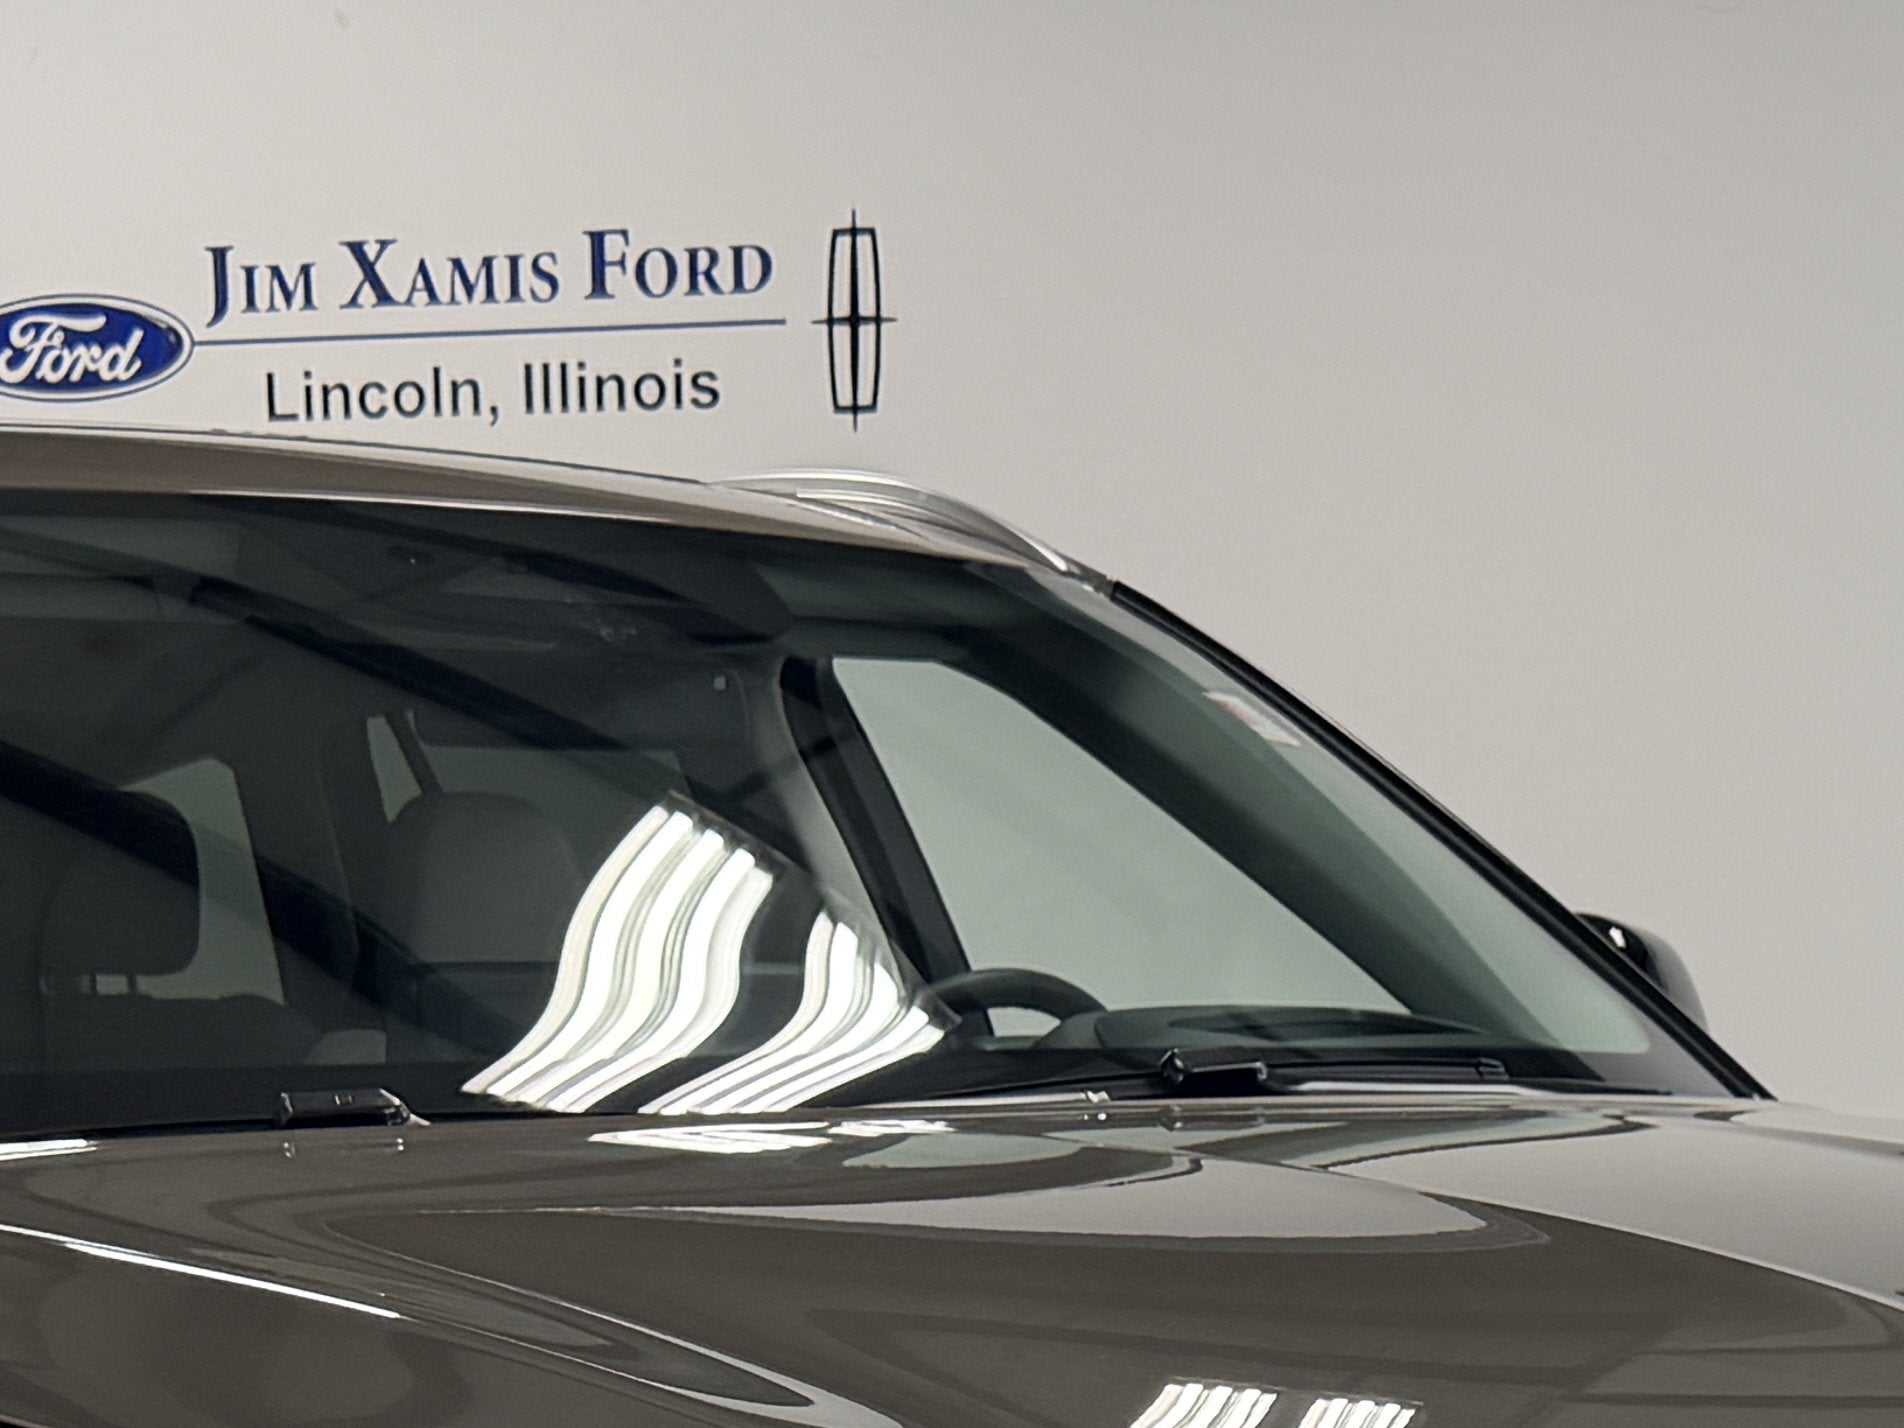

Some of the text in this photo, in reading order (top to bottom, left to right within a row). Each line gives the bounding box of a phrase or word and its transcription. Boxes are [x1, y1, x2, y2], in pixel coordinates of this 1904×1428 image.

[204, 228, 774, 329] JIM XAMIS FORD
[266, 357, 721, 427] Lincoln, Illinois
